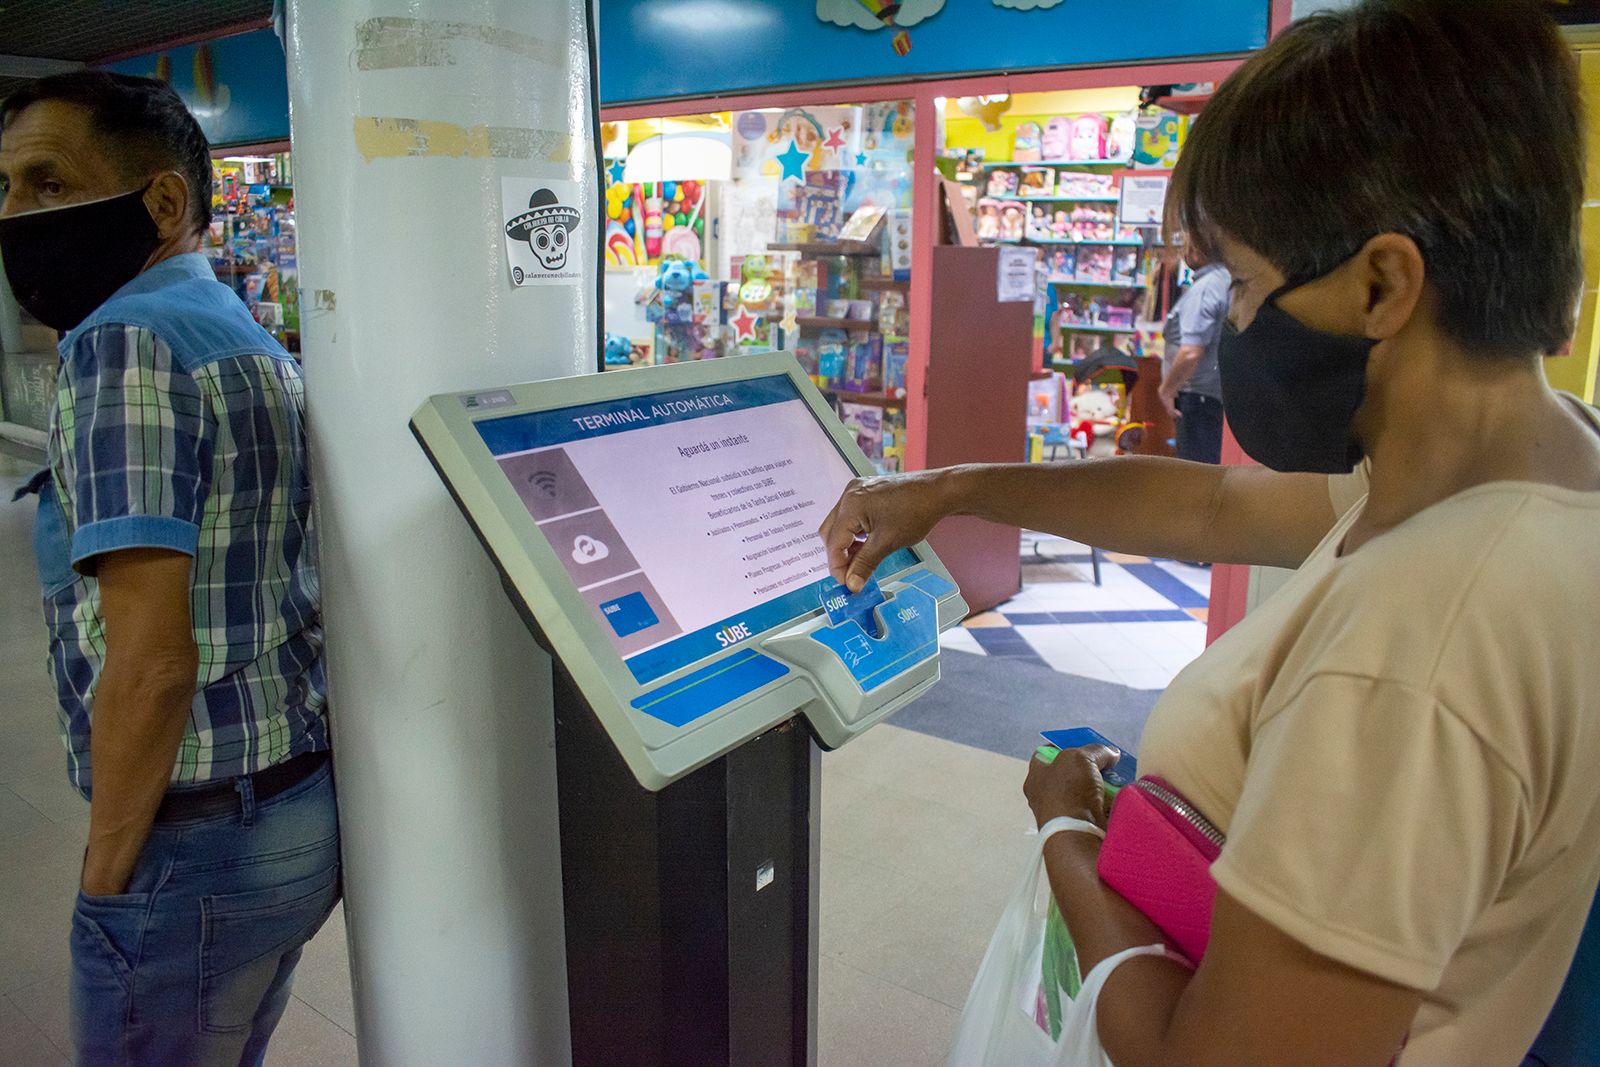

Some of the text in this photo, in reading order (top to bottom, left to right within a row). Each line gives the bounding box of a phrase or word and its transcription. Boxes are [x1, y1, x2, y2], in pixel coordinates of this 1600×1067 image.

[572, 393, 734, 431] TERMINAL AUTOMÁTICA
[677, 434, 749, 458] Aguardá un instante
[669, 487, 677, 495] El
[676, 483, 700, 493] Gobierno
[698, 476, 721, 487] Nacional
[774, 460, 787, 468] viajar
[710, 492, 728, 501] trenes
[730, 485, 754, 495] colectivos
[707, 506, 740, 519] Beneficiarios
[750, 497, 766, 506] Tarifa
[764, 493, 780, 503] Social
[745, 532, 763, 543] Personal
[604, 604, 621, 615] SUBE
[826, 594, 849, 612] SUBE
[897, 606, 919, 623] SUBE
[716, 622, 752, 647] SUBE
